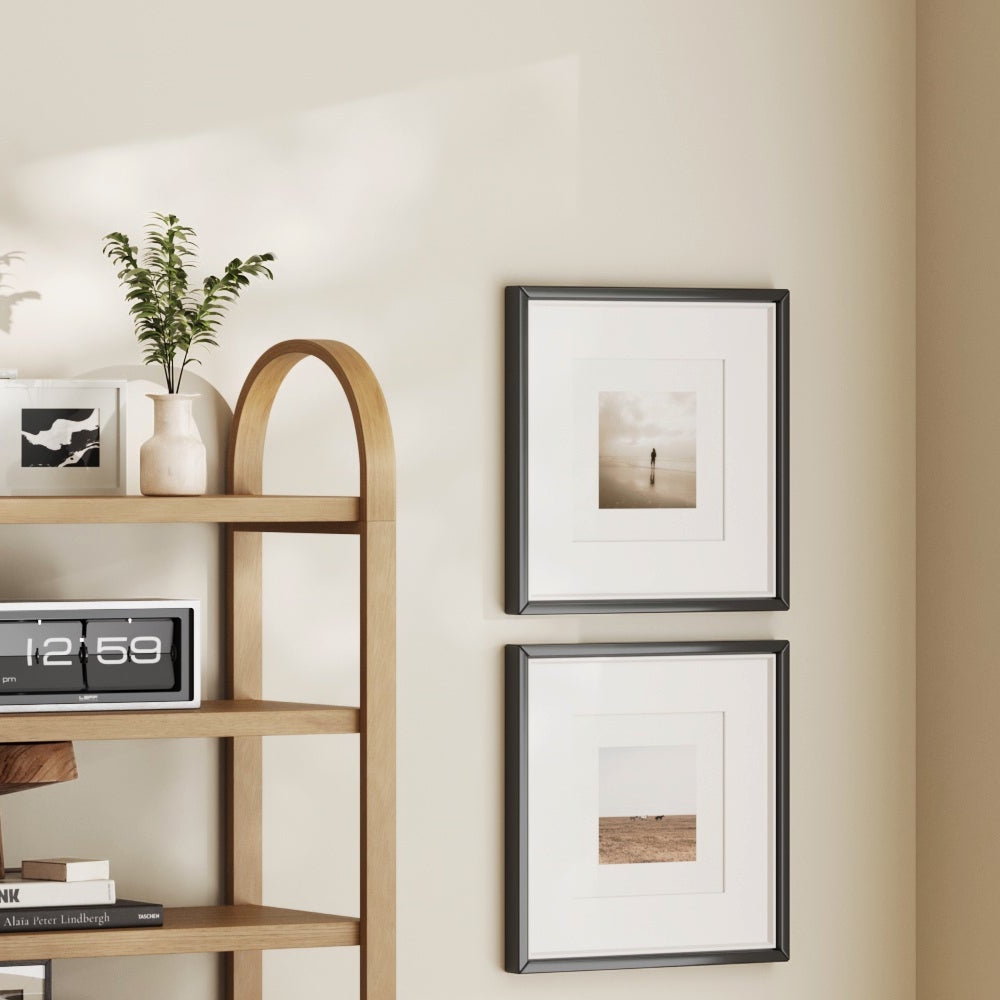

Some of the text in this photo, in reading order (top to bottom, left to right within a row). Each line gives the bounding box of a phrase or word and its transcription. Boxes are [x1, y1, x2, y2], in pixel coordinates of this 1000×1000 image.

[2, 676, 17, 684] pm
[33, 916, 57, 926] Peter
[61, 912, 110, 926] Lindbergh
